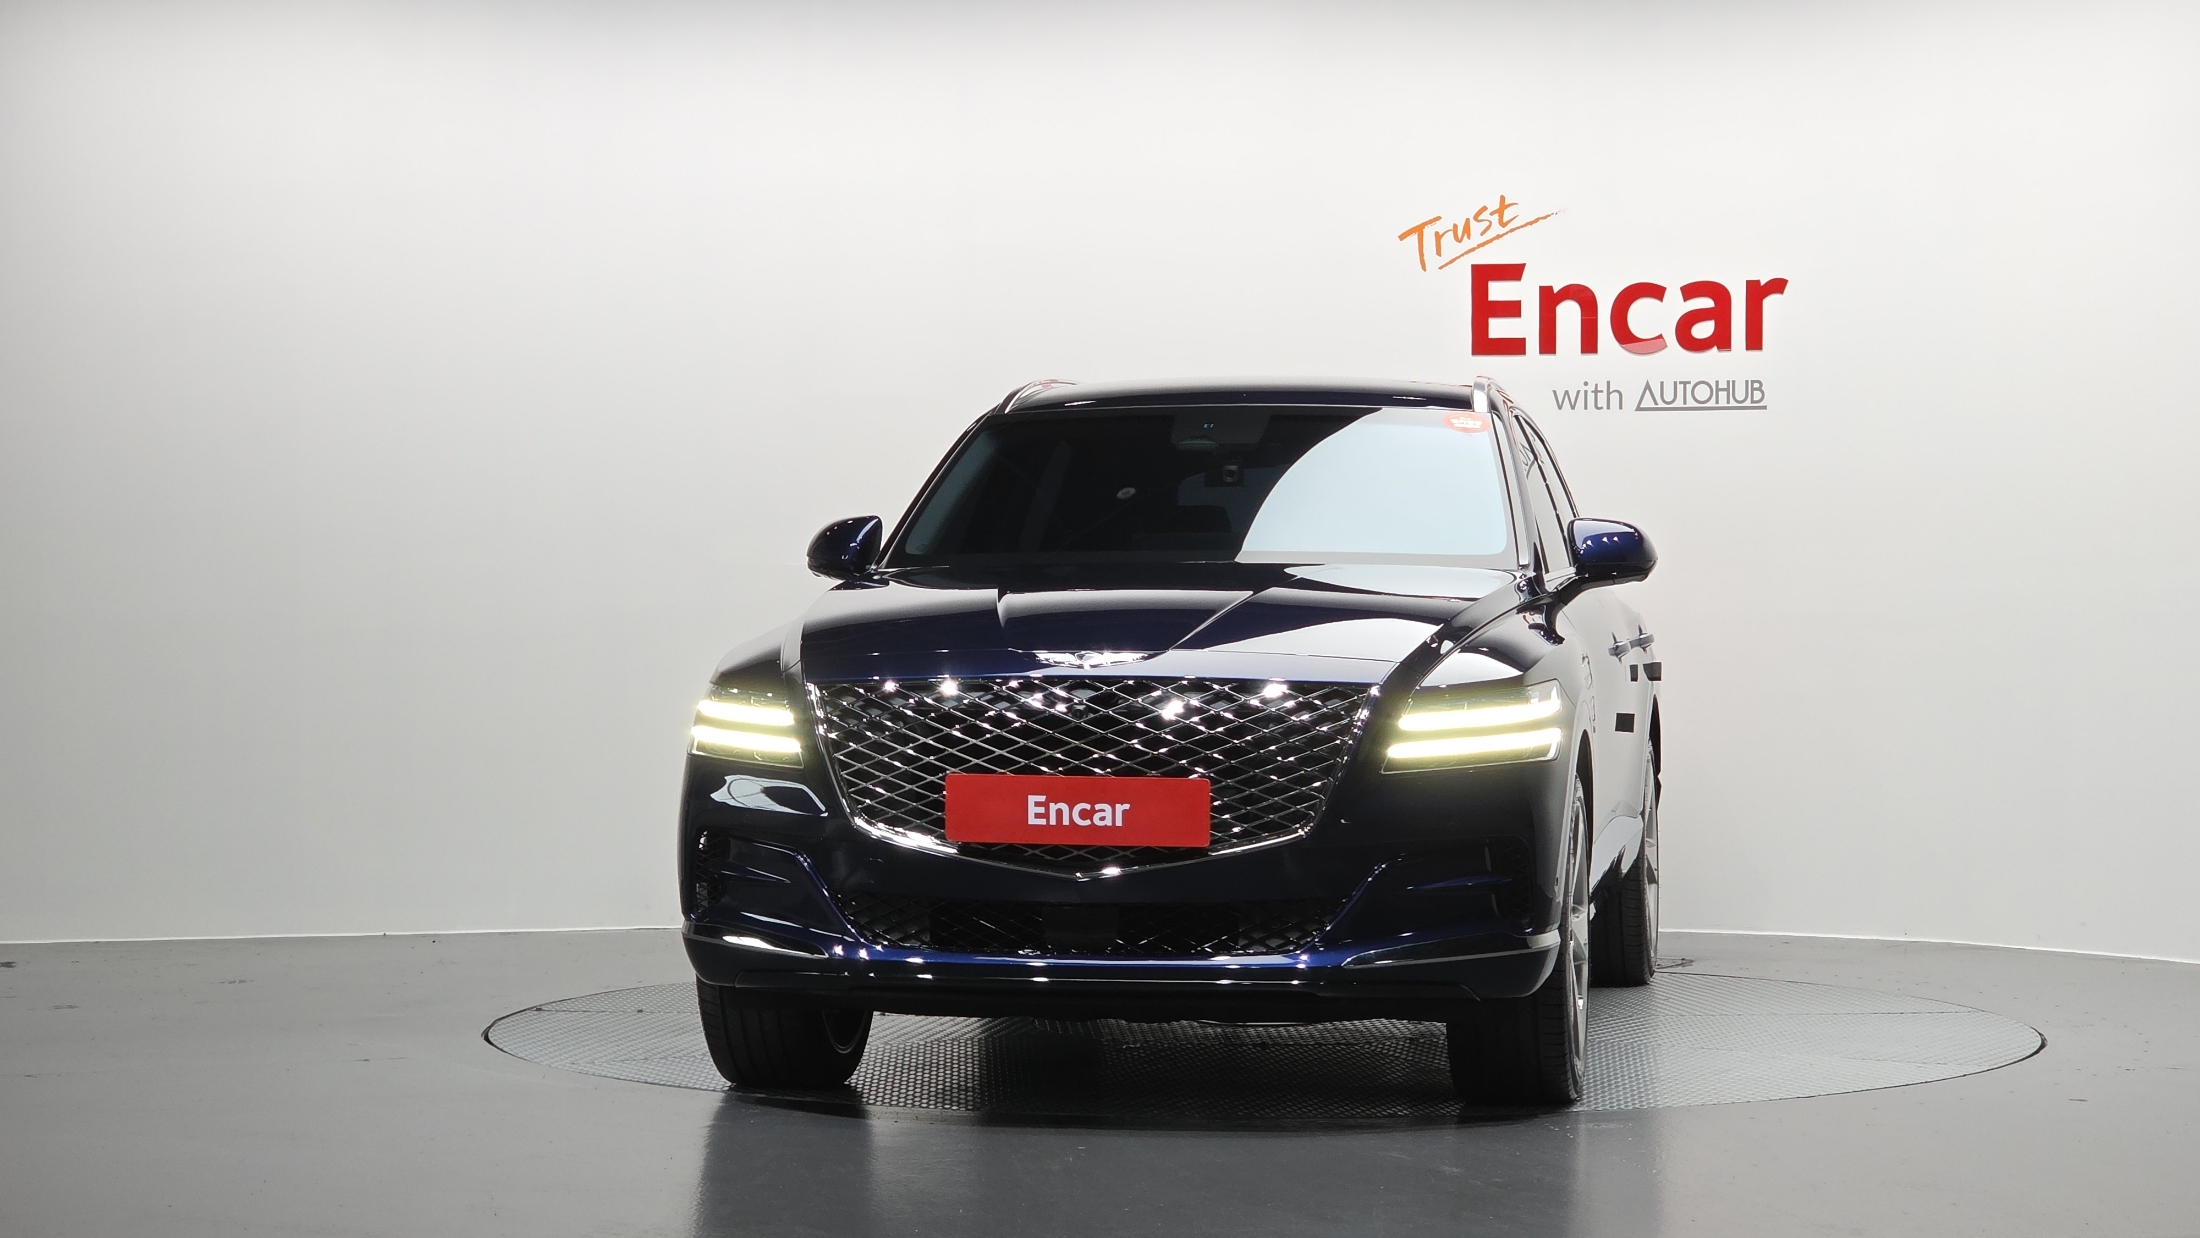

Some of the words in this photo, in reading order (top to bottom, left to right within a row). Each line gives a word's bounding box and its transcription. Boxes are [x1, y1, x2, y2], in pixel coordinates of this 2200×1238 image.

[1398, 194, 1519, 272] Trust
[1471, 263, 1788, 356] Encar
[1552, 380, 1623, 410] with
[1635, 379, 1767, 411] AUTOHUB
[1027, 794, 1130, 827] Encar
